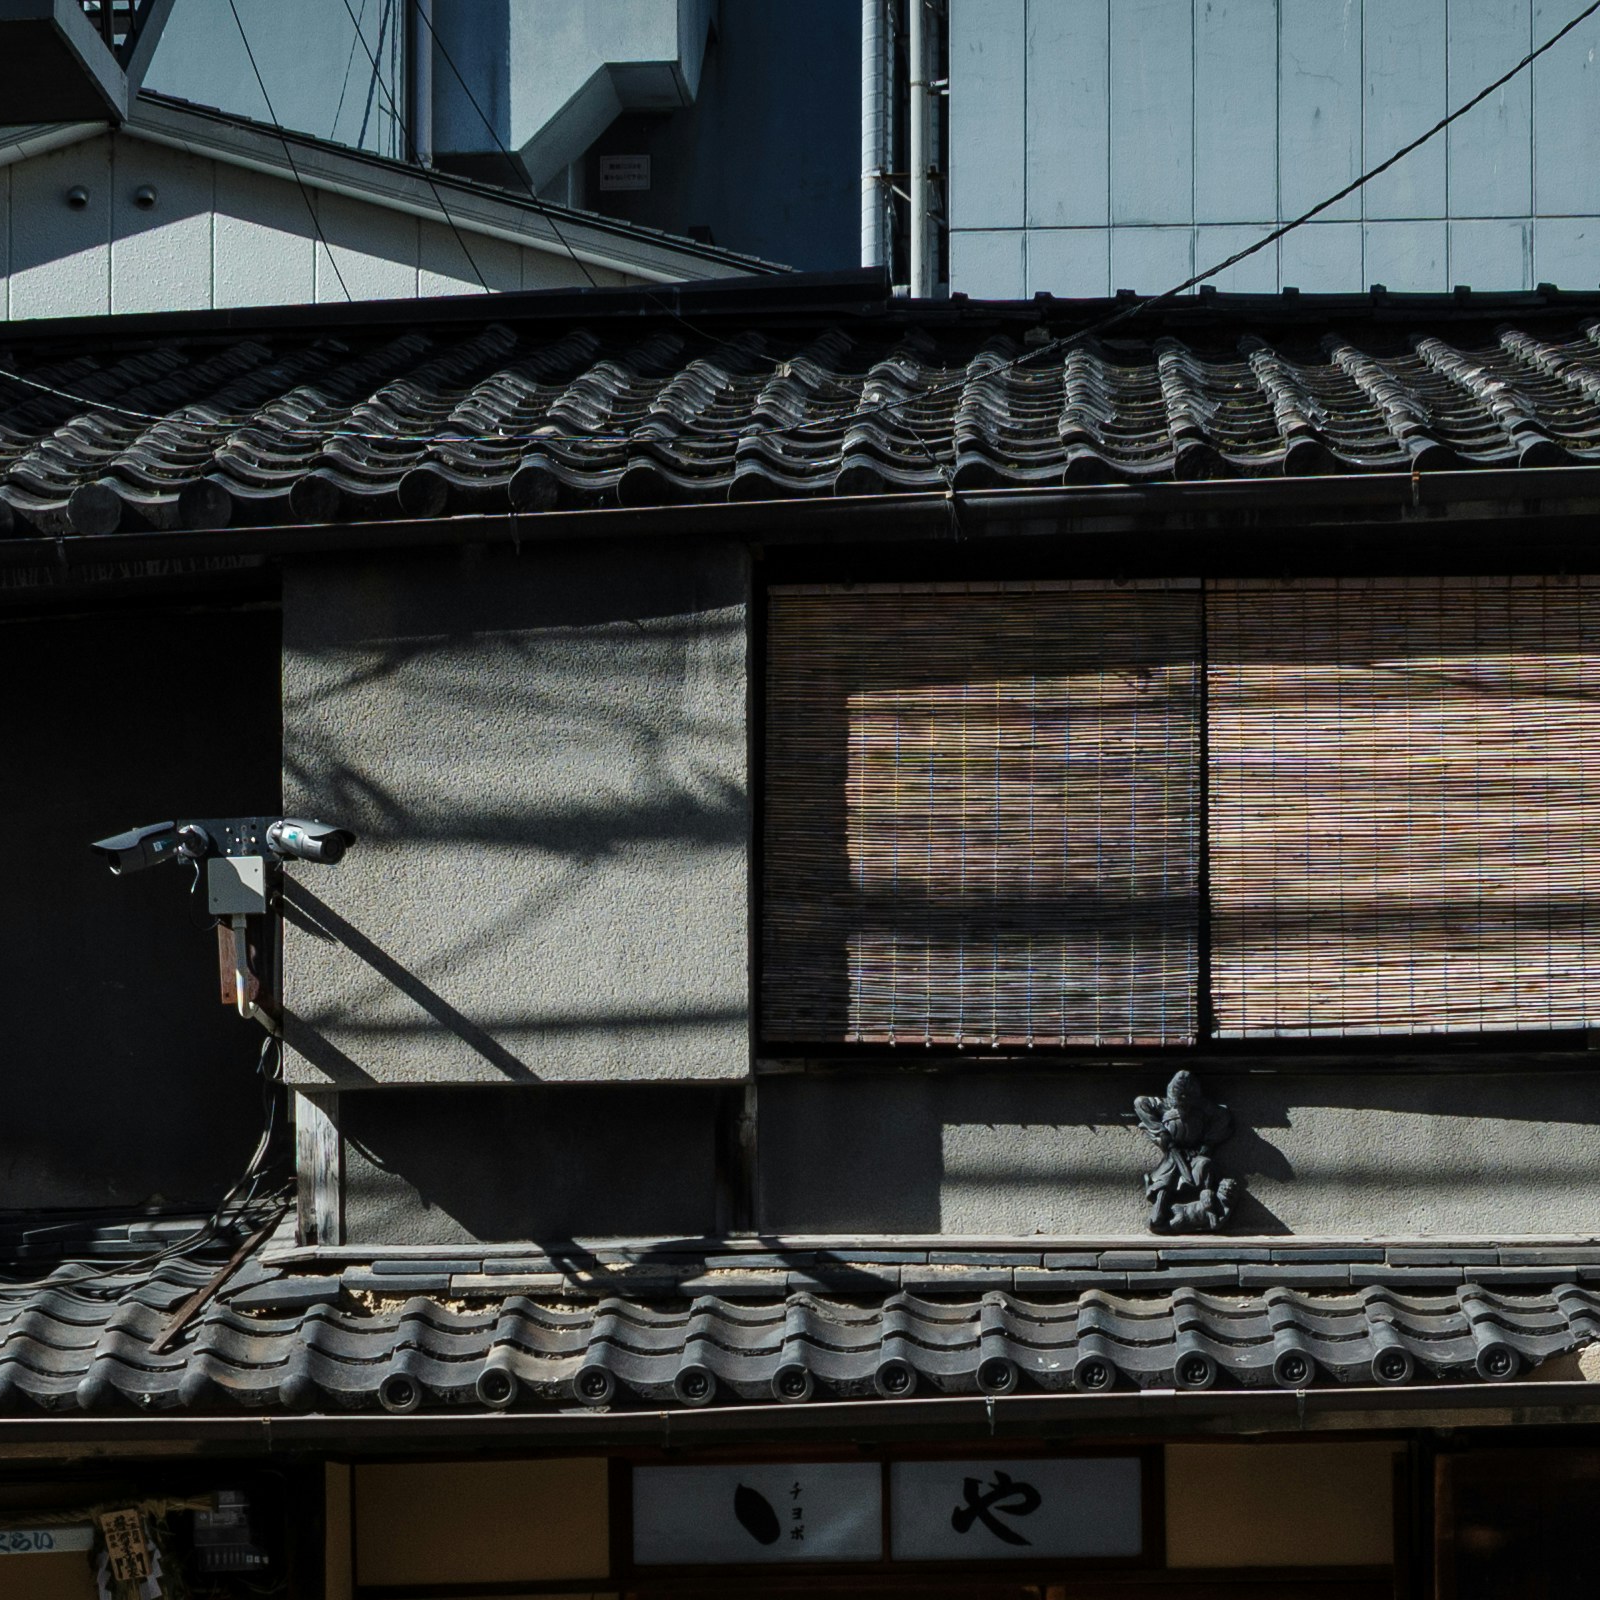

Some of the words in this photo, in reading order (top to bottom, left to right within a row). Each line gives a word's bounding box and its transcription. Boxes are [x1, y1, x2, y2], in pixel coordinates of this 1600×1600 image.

[789, 1482, 805, 1541] チョボ
[951, 1470, 1042, 1546] や
